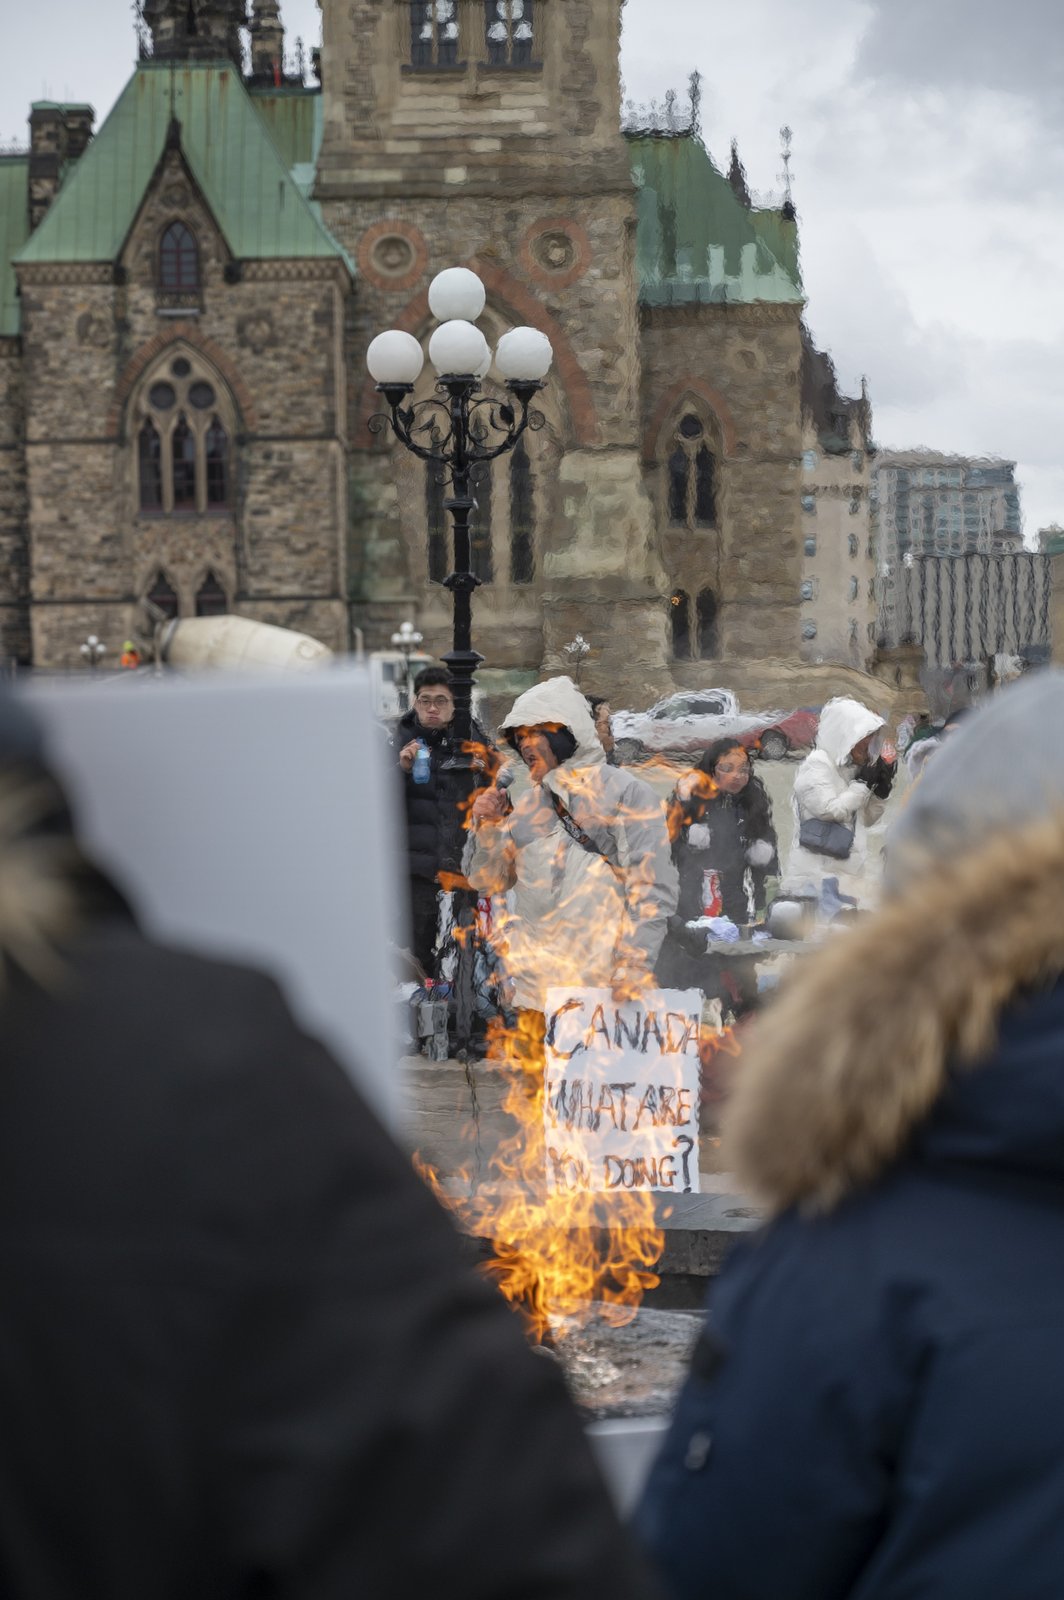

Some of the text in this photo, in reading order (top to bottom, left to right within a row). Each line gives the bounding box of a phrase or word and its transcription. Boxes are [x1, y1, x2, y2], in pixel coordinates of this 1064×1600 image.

[546, 998, 699, 1060] CANADA
[547, 1079, 691, 1132] WHAT ARE
[603, 1134, 694, 1194] DOING?
